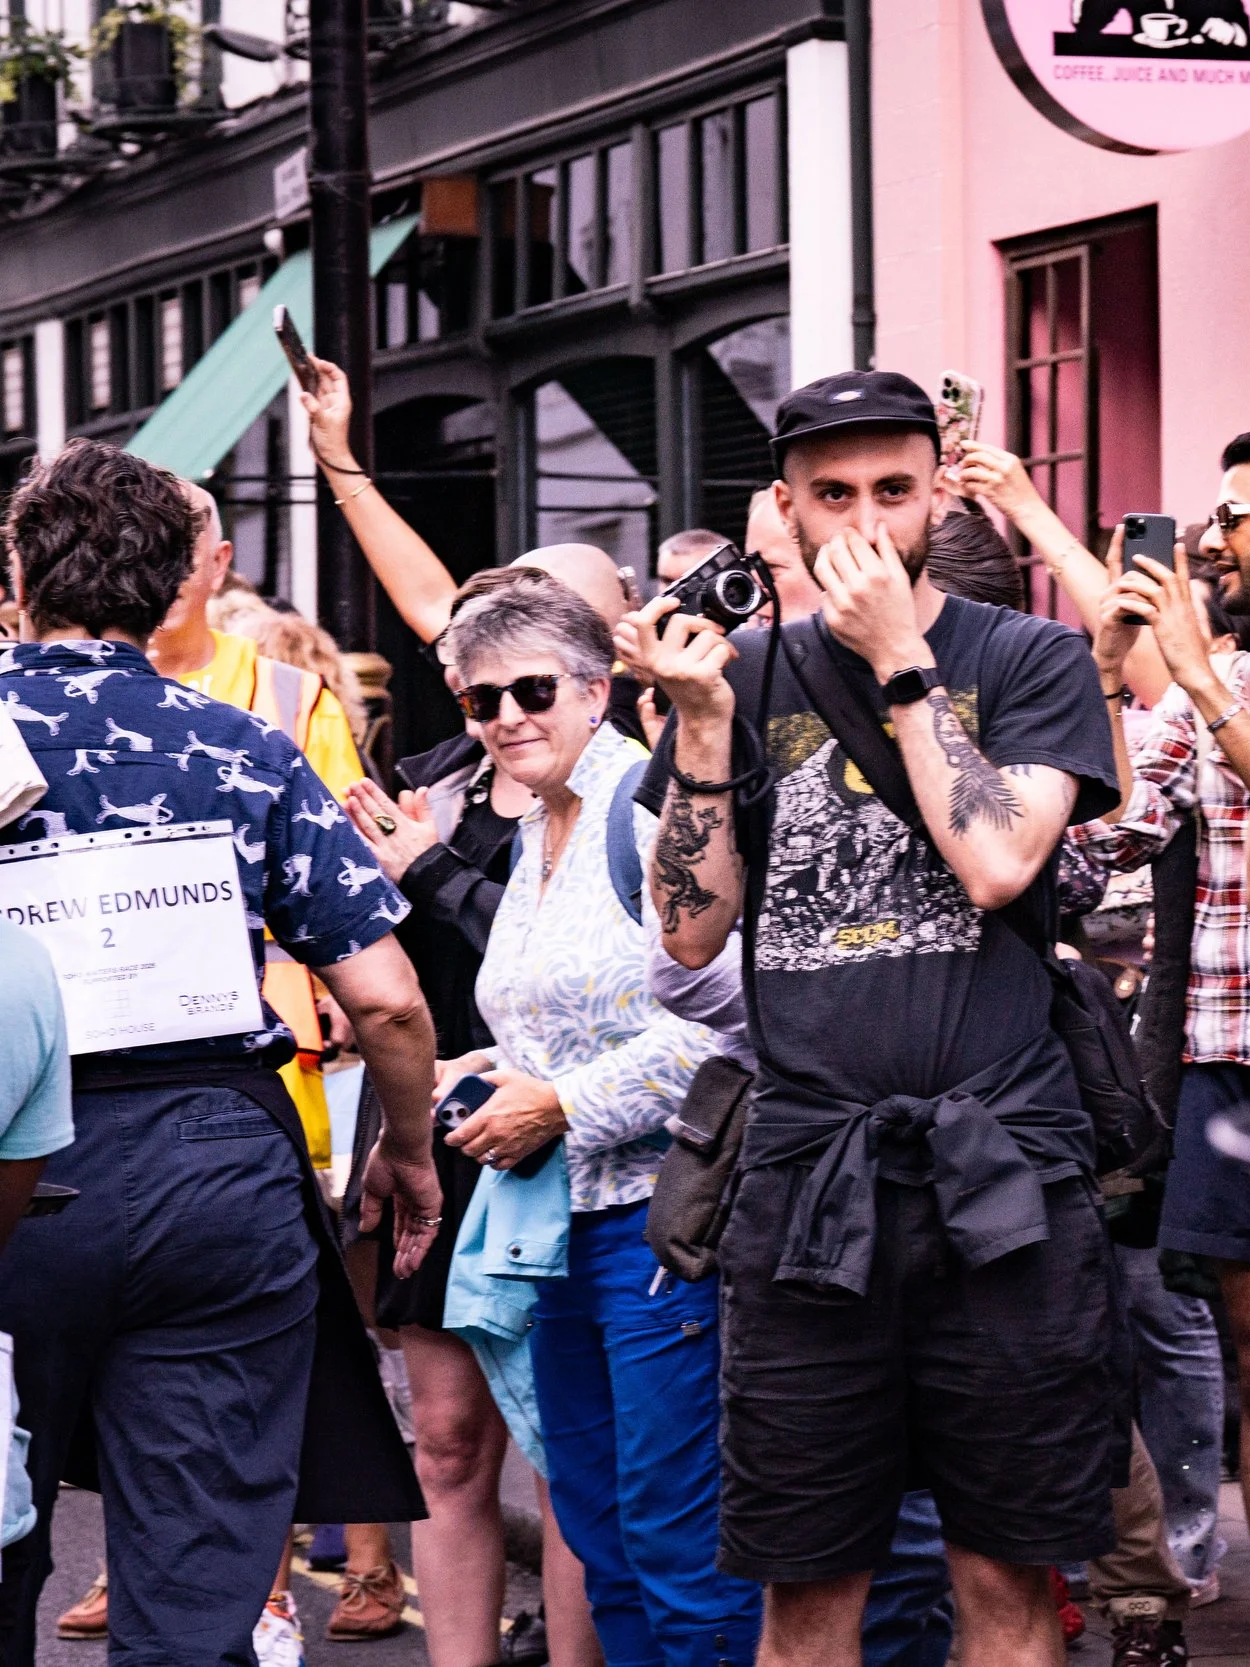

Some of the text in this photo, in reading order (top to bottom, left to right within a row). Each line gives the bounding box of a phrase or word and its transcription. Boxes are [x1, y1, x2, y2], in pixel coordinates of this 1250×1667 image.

[1113, 67, 1153, 83] JUICE
[1158, 69, 1188, 83] AND
[1192, 69, 1235, 85] MUCH
[0, 880, 233, 926] DREW EDMUNDS
[100, 926, 116, 949] 2
[119, 1022, 156, 1035] HOUSE
